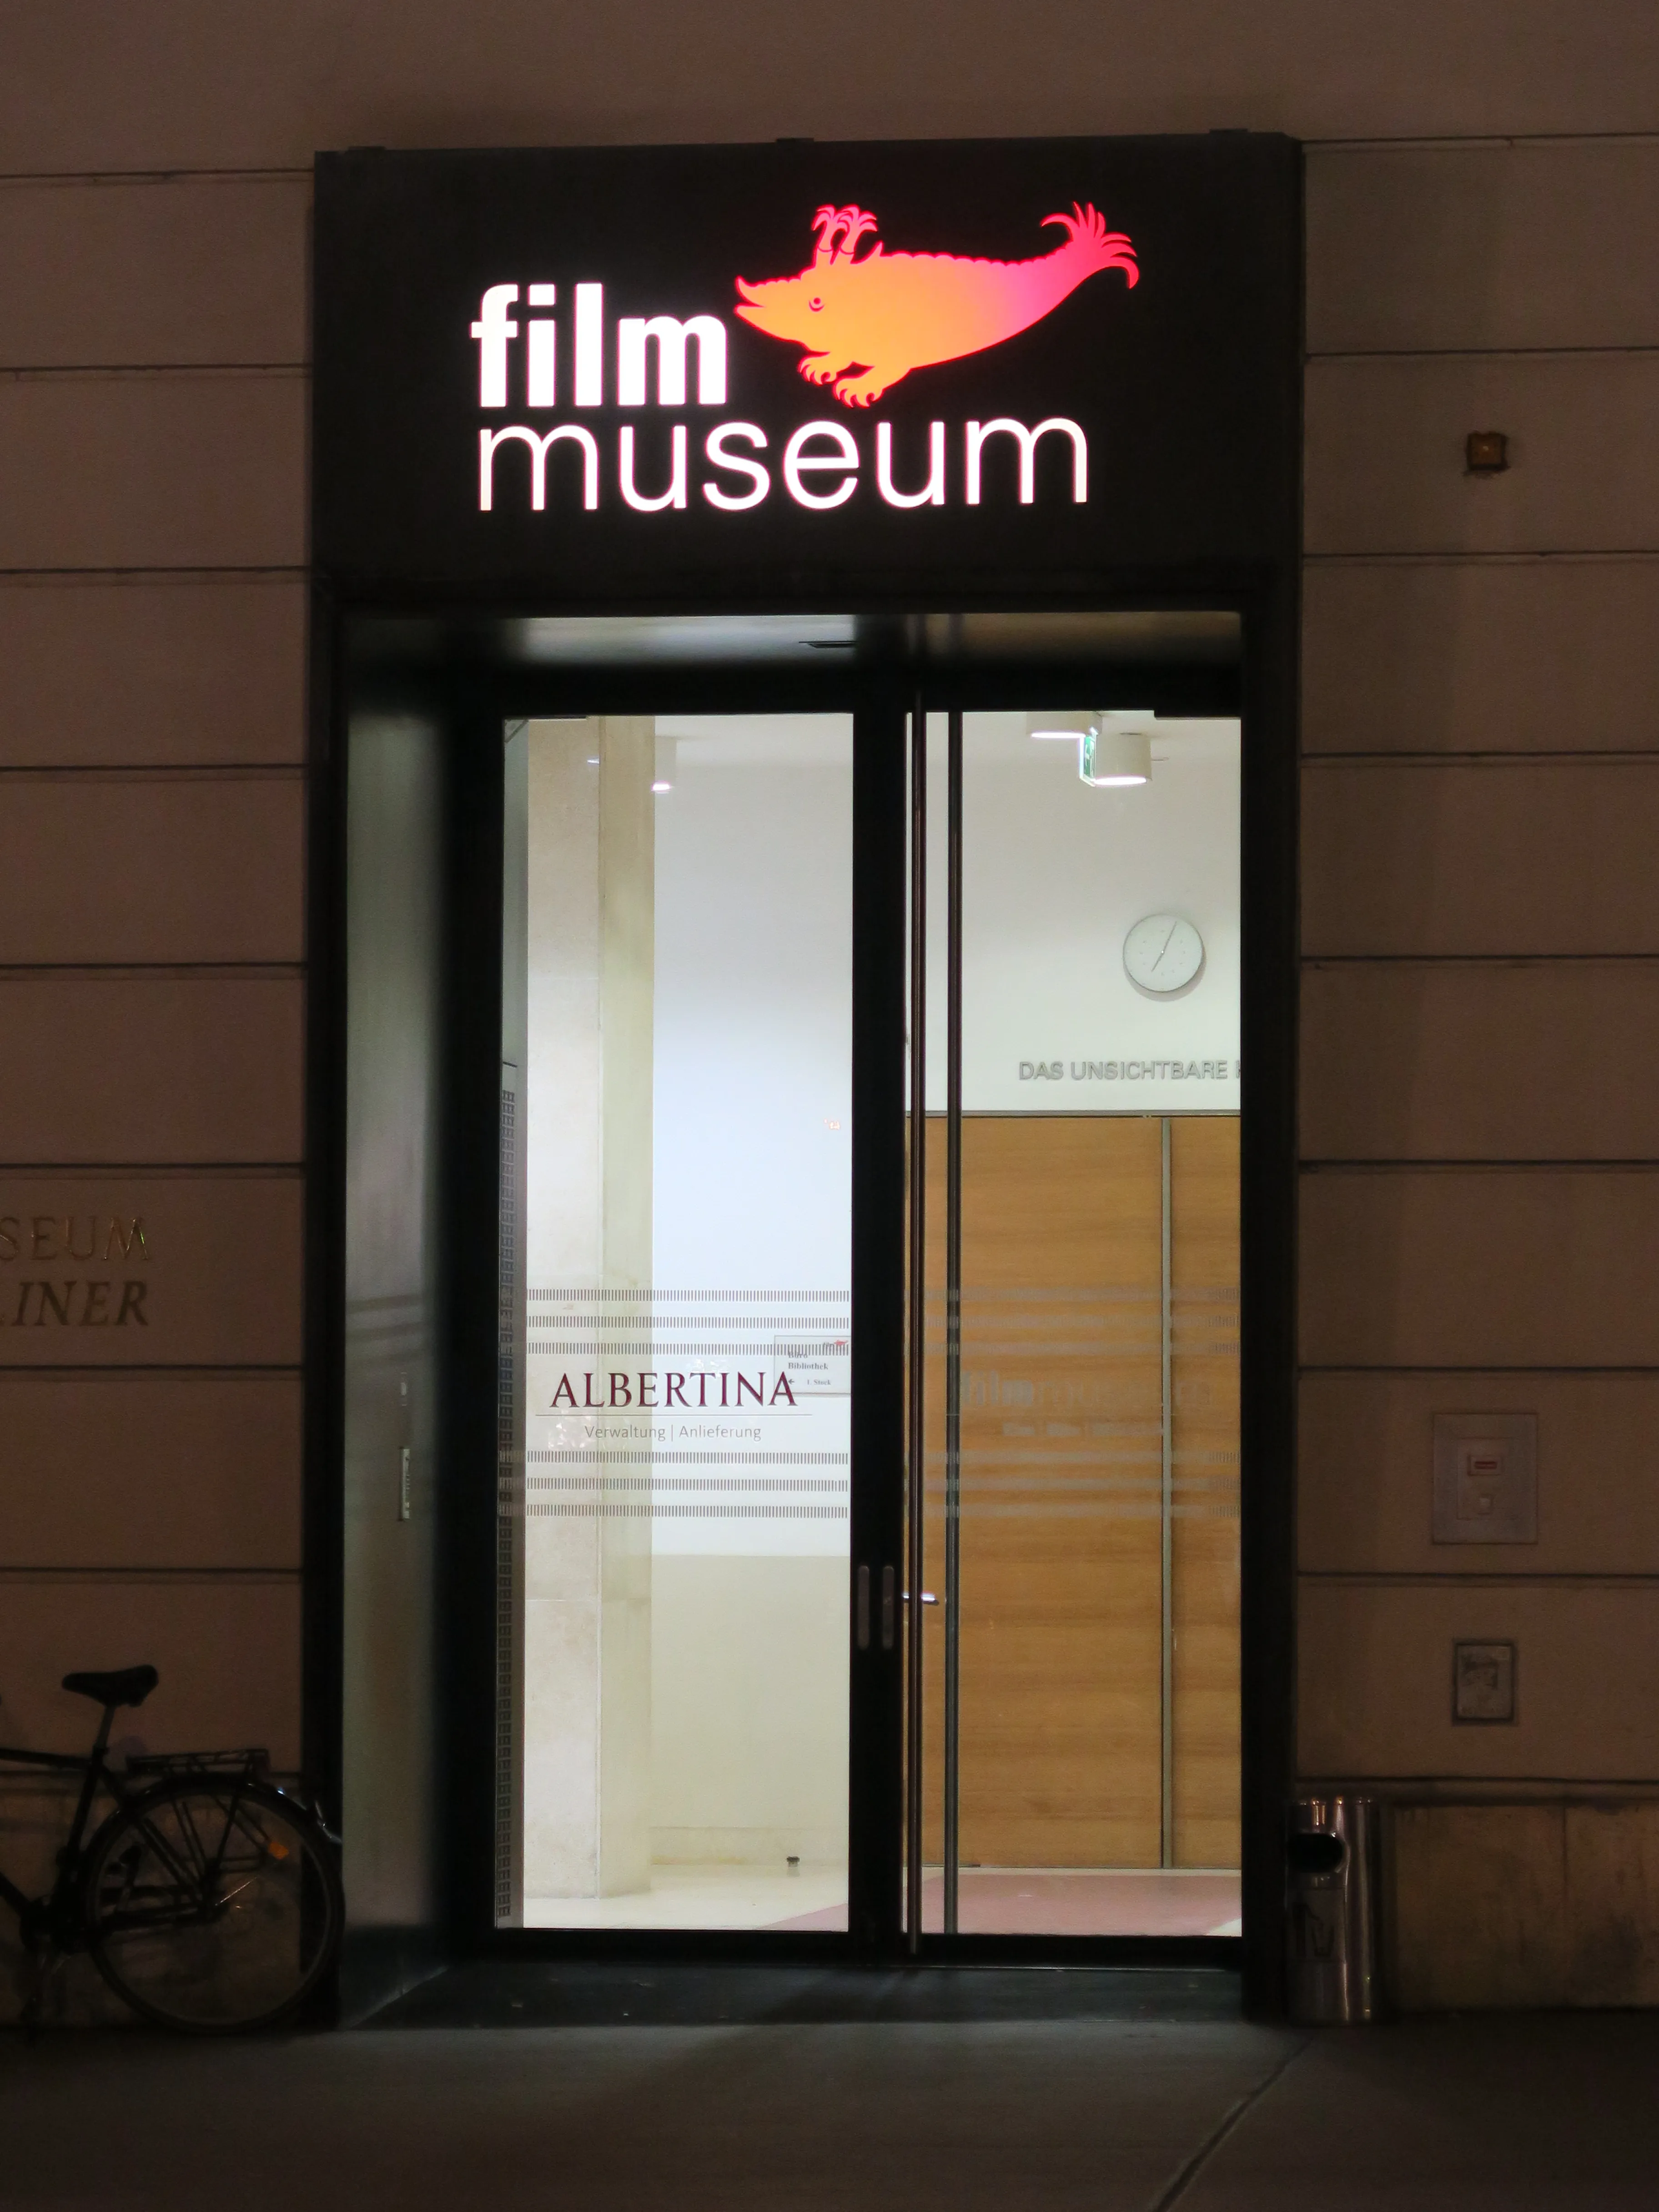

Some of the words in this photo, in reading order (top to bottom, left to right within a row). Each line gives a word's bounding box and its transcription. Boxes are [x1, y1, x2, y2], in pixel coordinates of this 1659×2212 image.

[470, 282, 728, 407] film
[478, 417, 1090, 511] museum
[1019, 1061, 1064, 1080] DAS
[1071, 1060, 1227, 1080] UNSICHTBARE
[0, 1281, 148, 1327] INER
[549, 1371, 798, 1408] ALBERTINA
[584, 1425, 666, 1442] Verwaltung
[679, 1425, 762, 1442] Anlieferung
